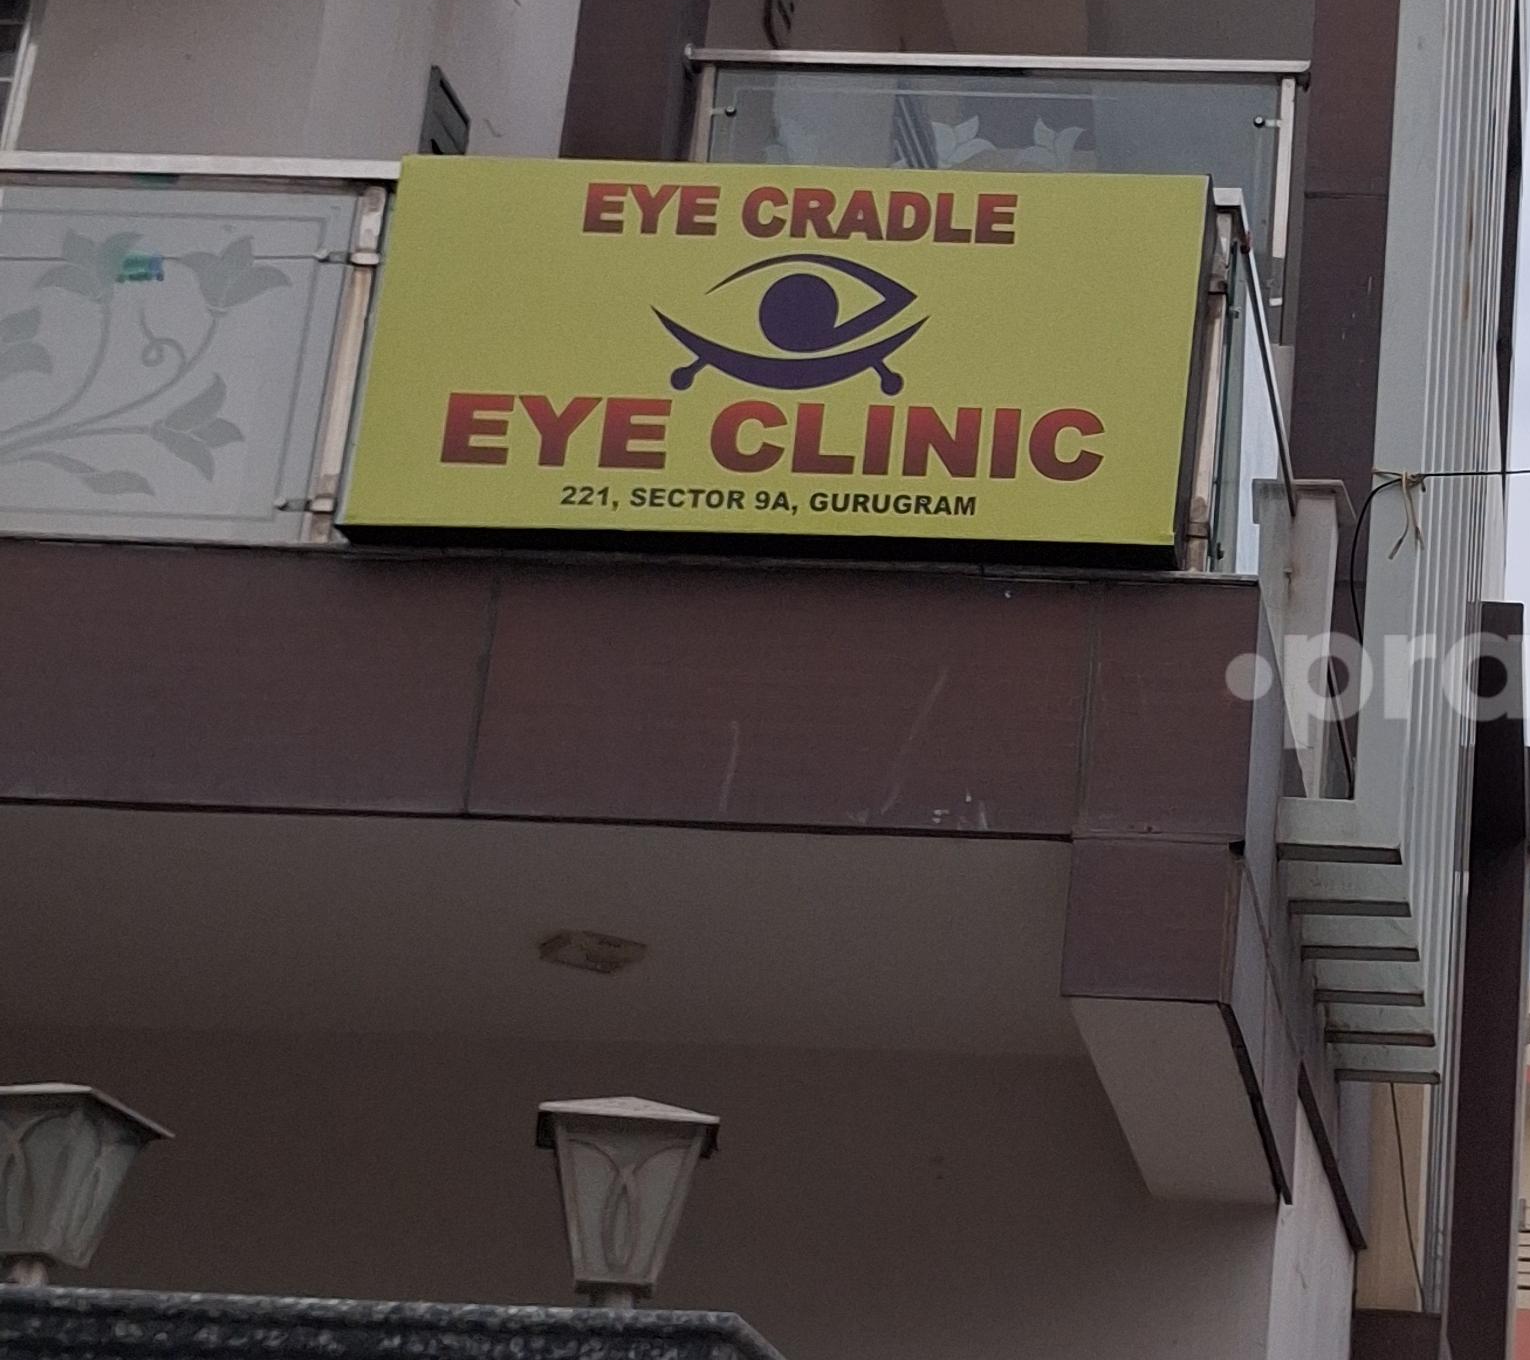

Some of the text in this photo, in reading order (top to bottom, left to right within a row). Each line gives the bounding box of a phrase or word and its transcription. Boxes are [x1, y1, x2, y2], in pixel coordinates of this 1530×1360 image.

[583, 183, 1018, 244] EYE CRADLE
[441, 393, 1105, 481] EYE CLINIC
[560, 485, 977, 516] 221, SECTOR 9A, GURUGRAM
